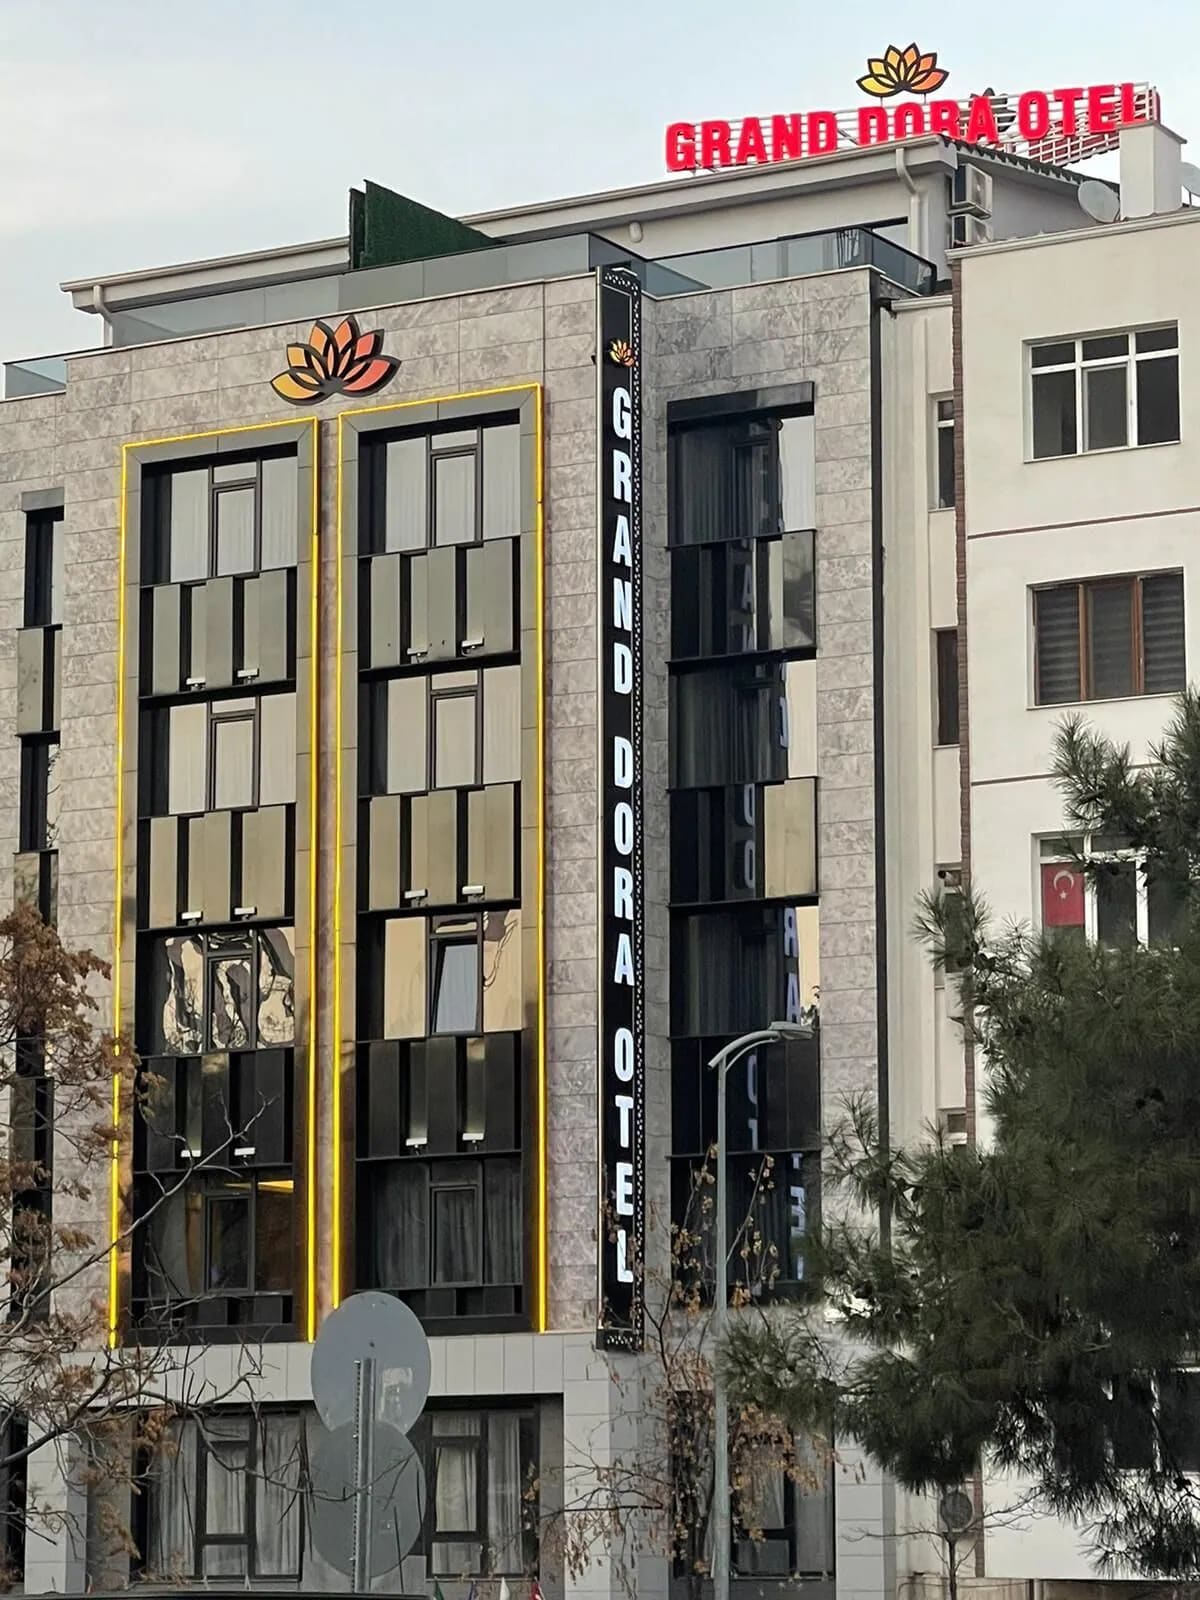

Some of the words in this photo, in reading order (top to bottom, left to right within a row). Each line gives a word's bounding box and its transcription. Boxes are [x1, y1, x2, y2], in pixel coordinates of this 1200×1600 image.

[665, 111, 838, 172] GRAND
[1017, 83, 1147, 140] OTEL
[612, 387, 633, 695] GRAND
[613, 735, 635, 986] DORA
[614, 1027, 634, 1283] OTEL
